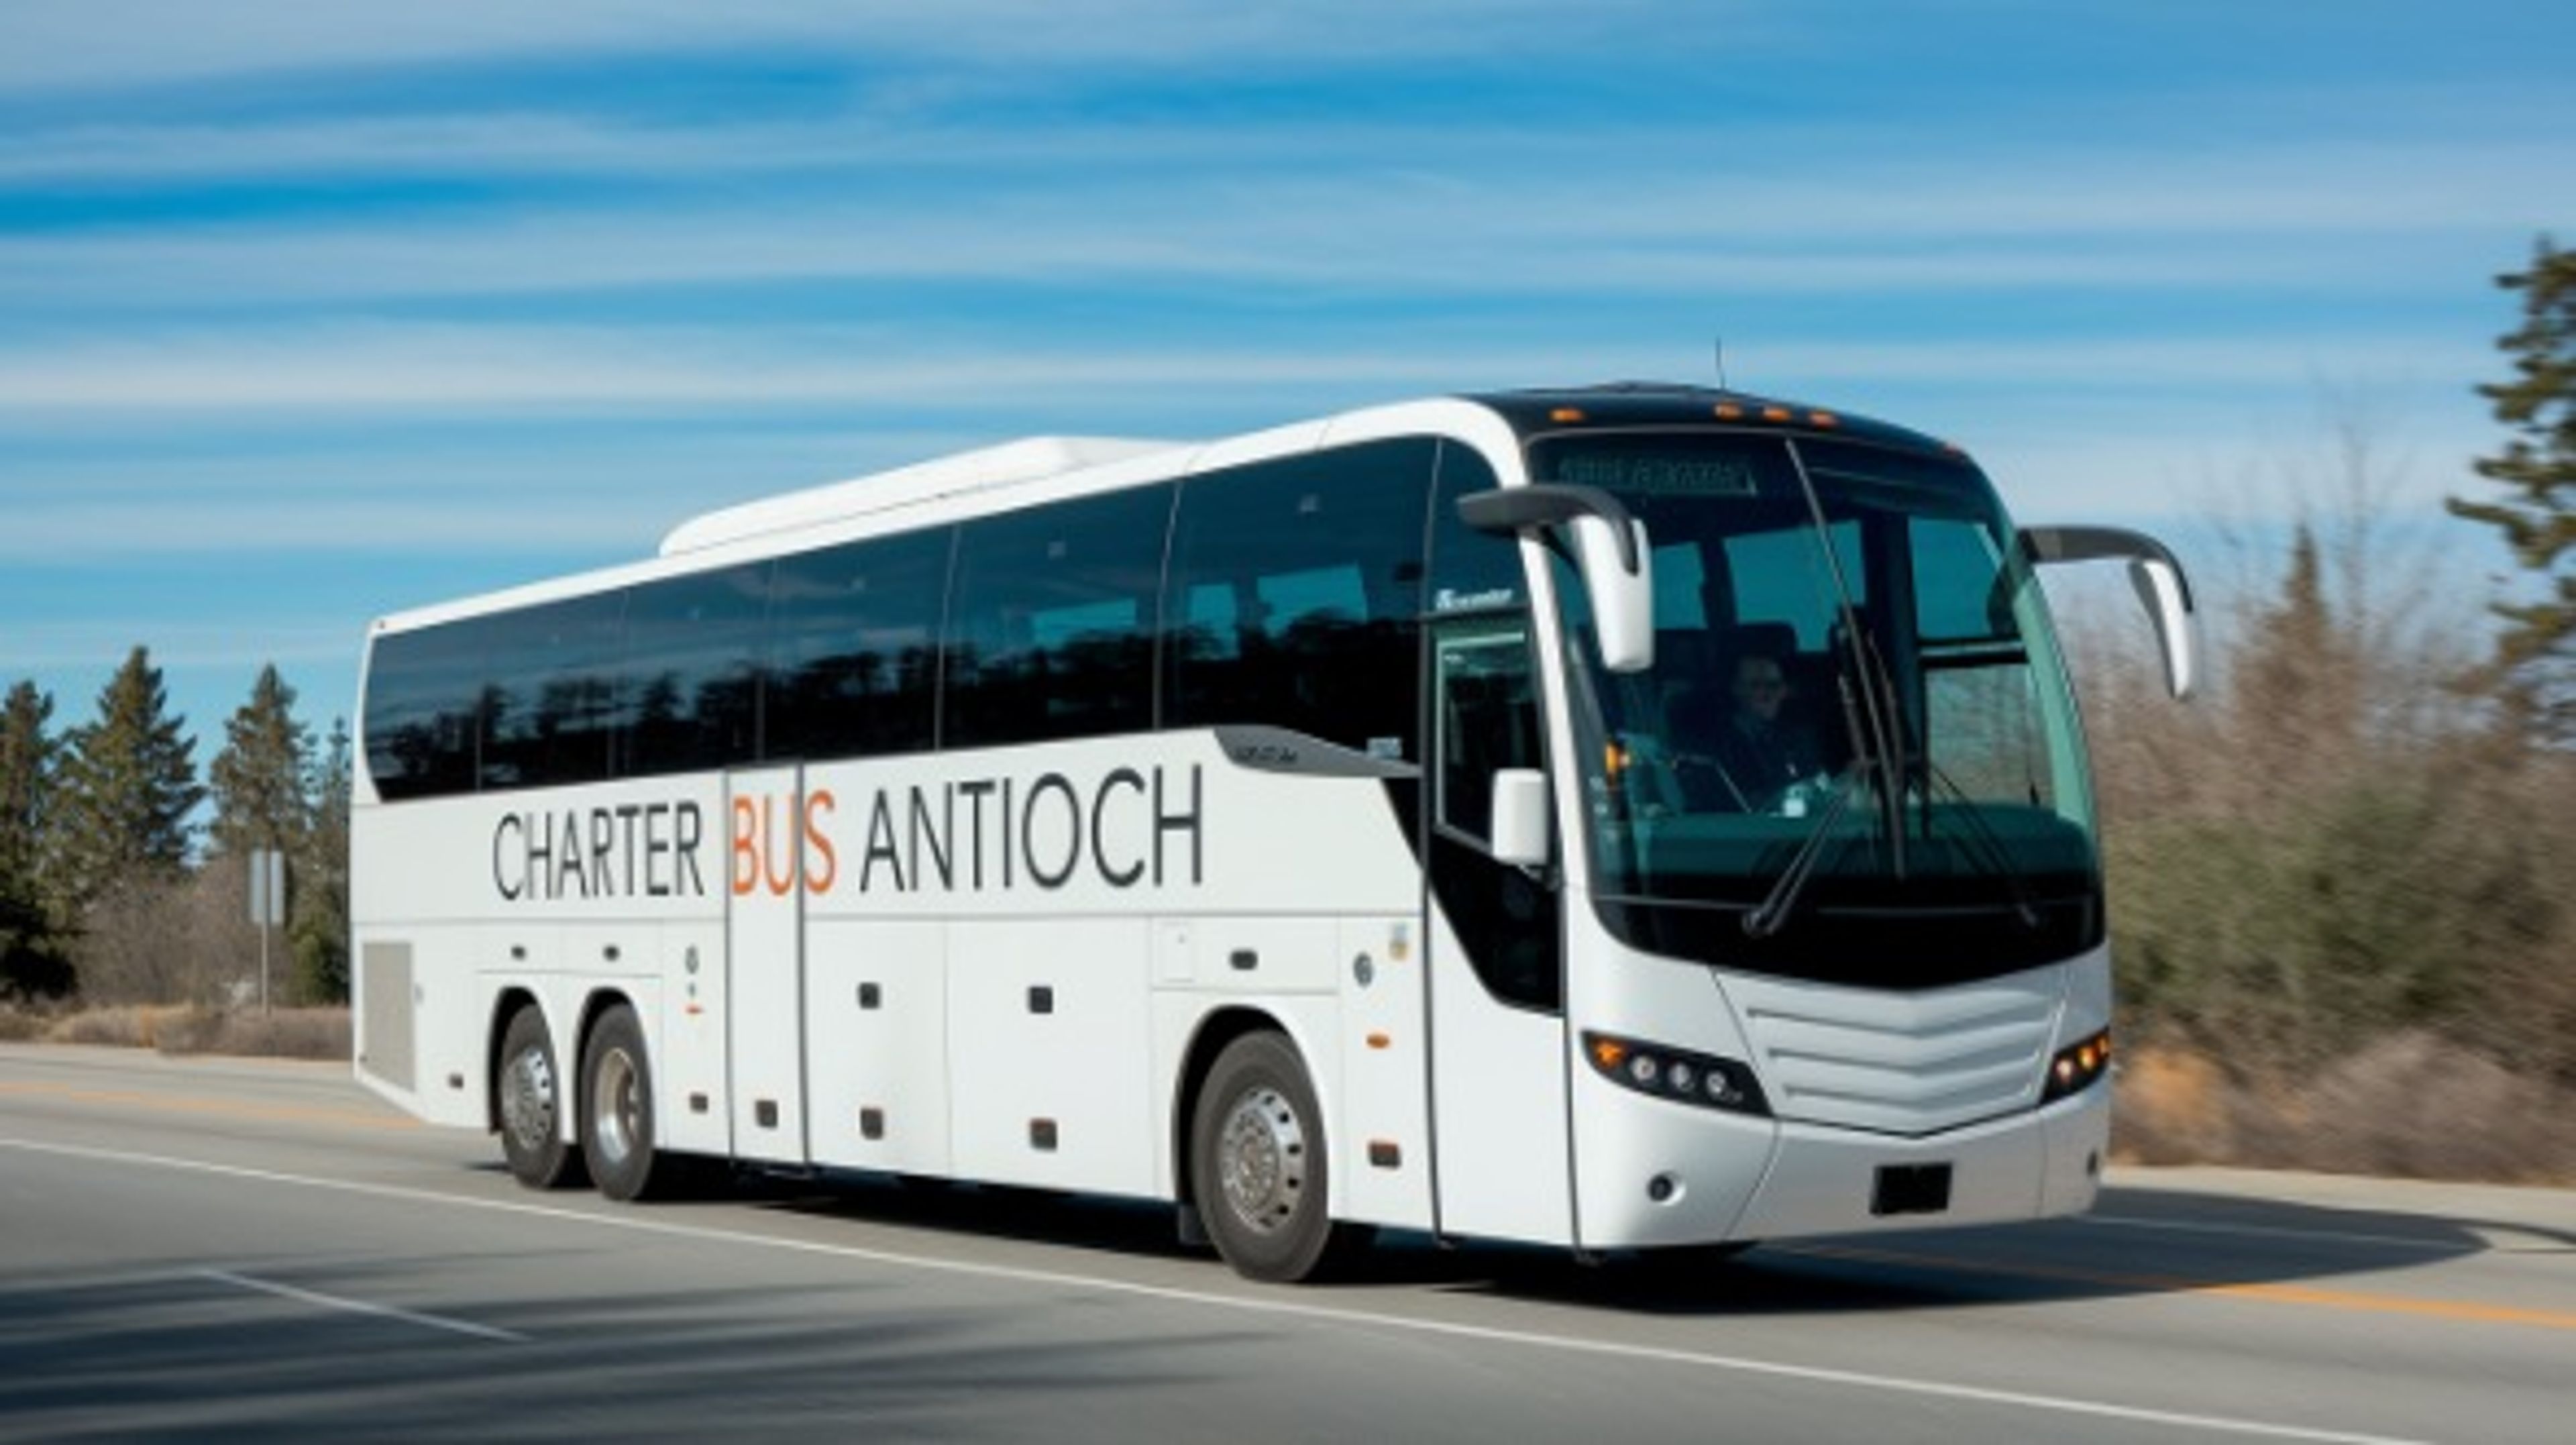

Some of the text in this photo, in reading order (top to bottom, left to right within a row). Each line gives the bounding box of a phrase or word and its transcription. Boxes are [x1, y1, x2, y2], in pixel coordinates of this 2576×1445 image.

[493, 763, 1204, 902] CHARTER BUS ANTIOCH
